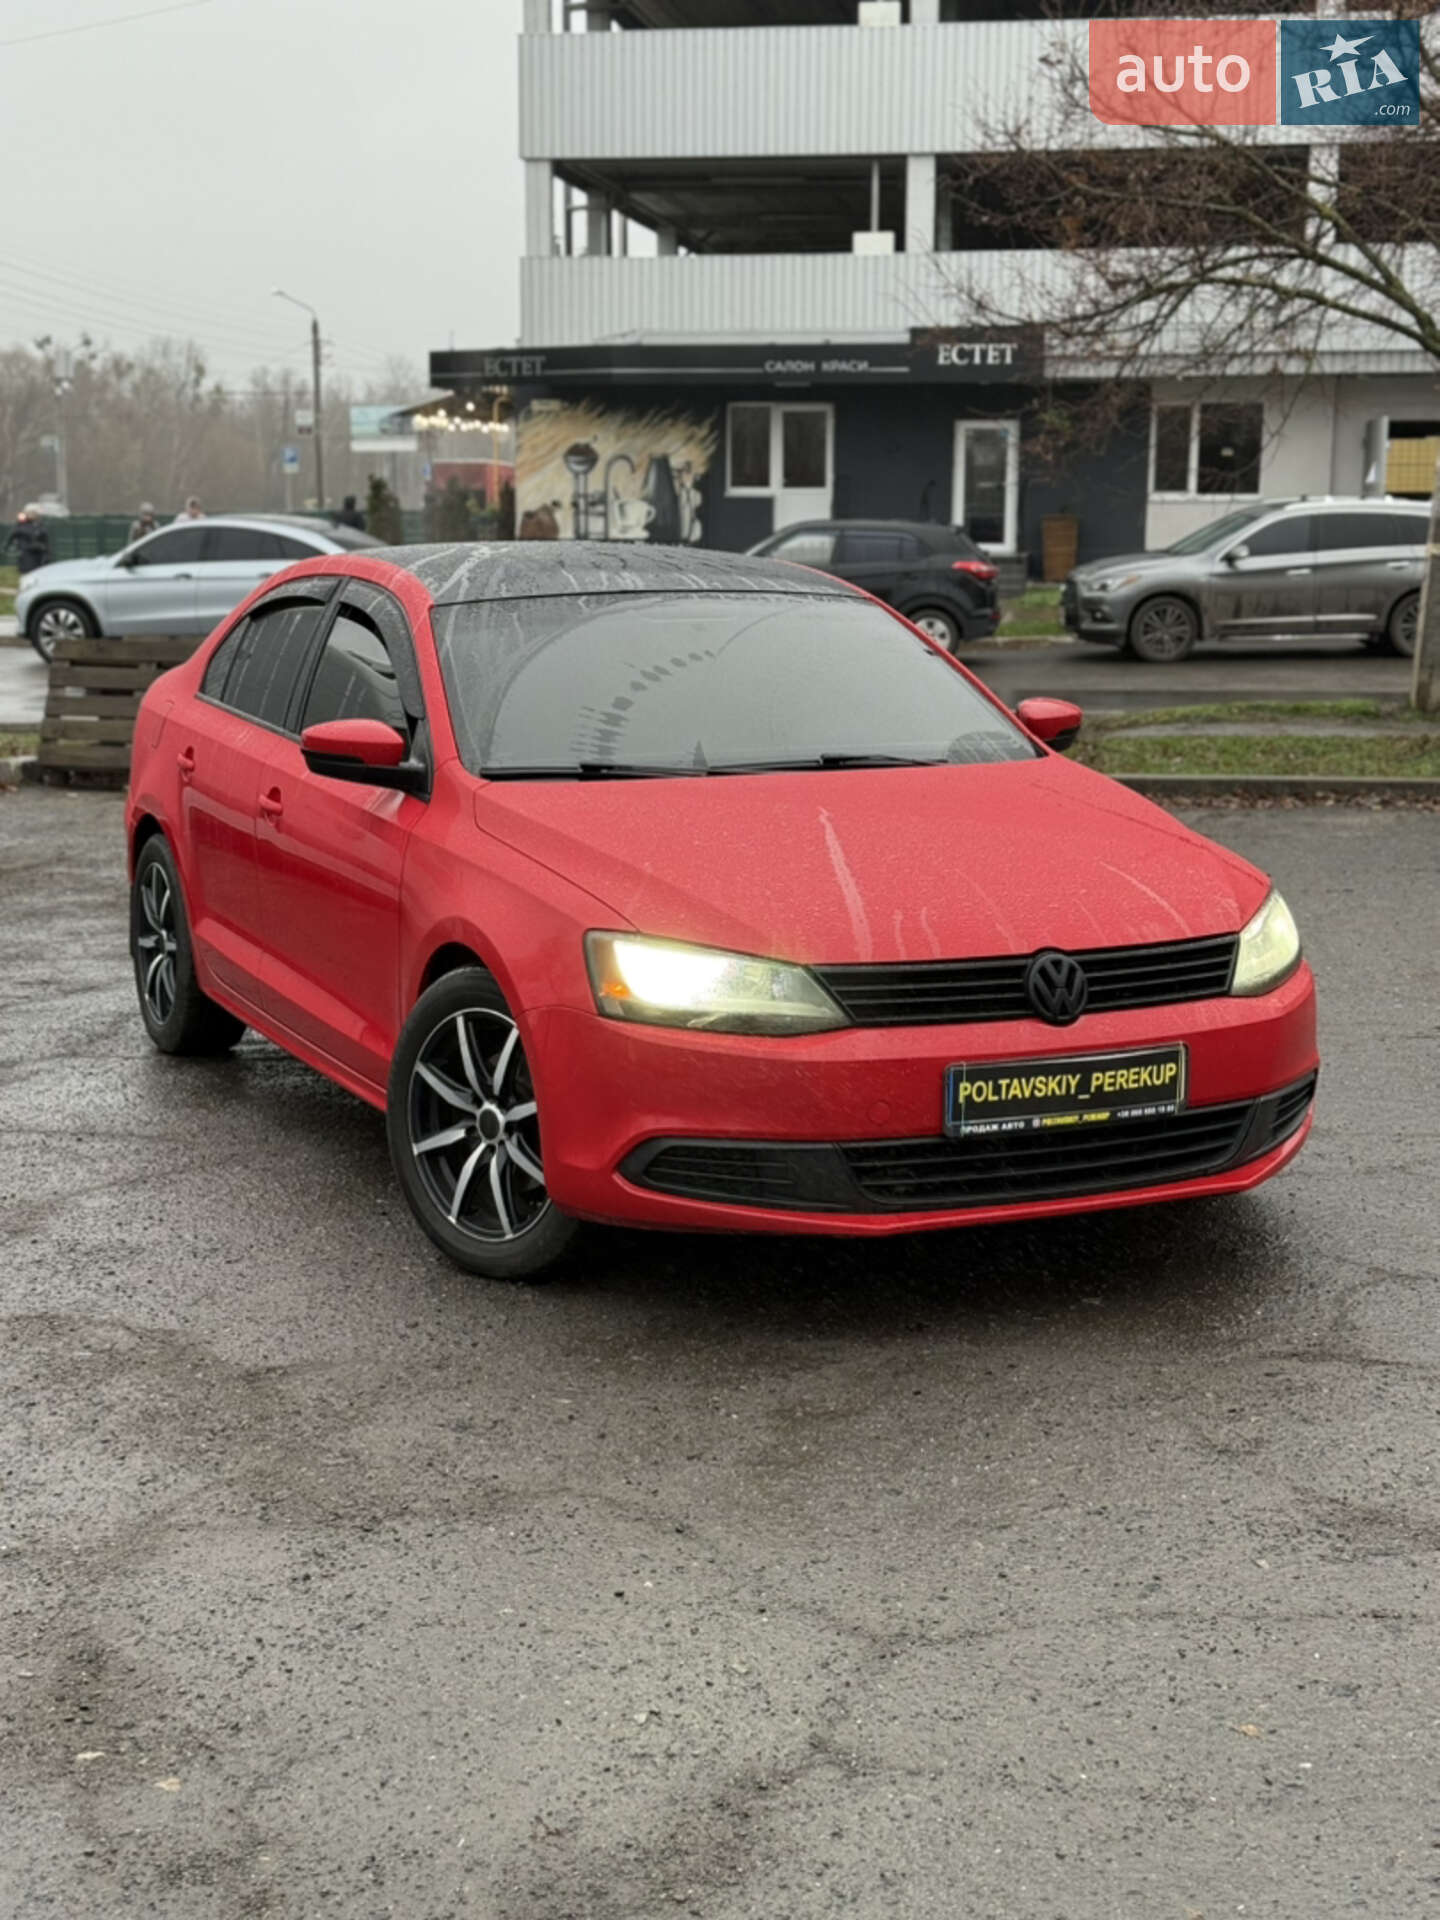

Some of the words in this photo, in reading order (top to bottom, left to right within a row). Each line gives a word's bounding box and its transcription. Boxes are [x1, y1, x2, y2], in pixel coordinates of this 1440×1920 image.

[764, 359, 816, 373] САЛОН
[936, 342, 1018, 366] ЕСТЕТ
[958, 1061, 1178, 1104] POLTAVSKIY_PEREKUP
